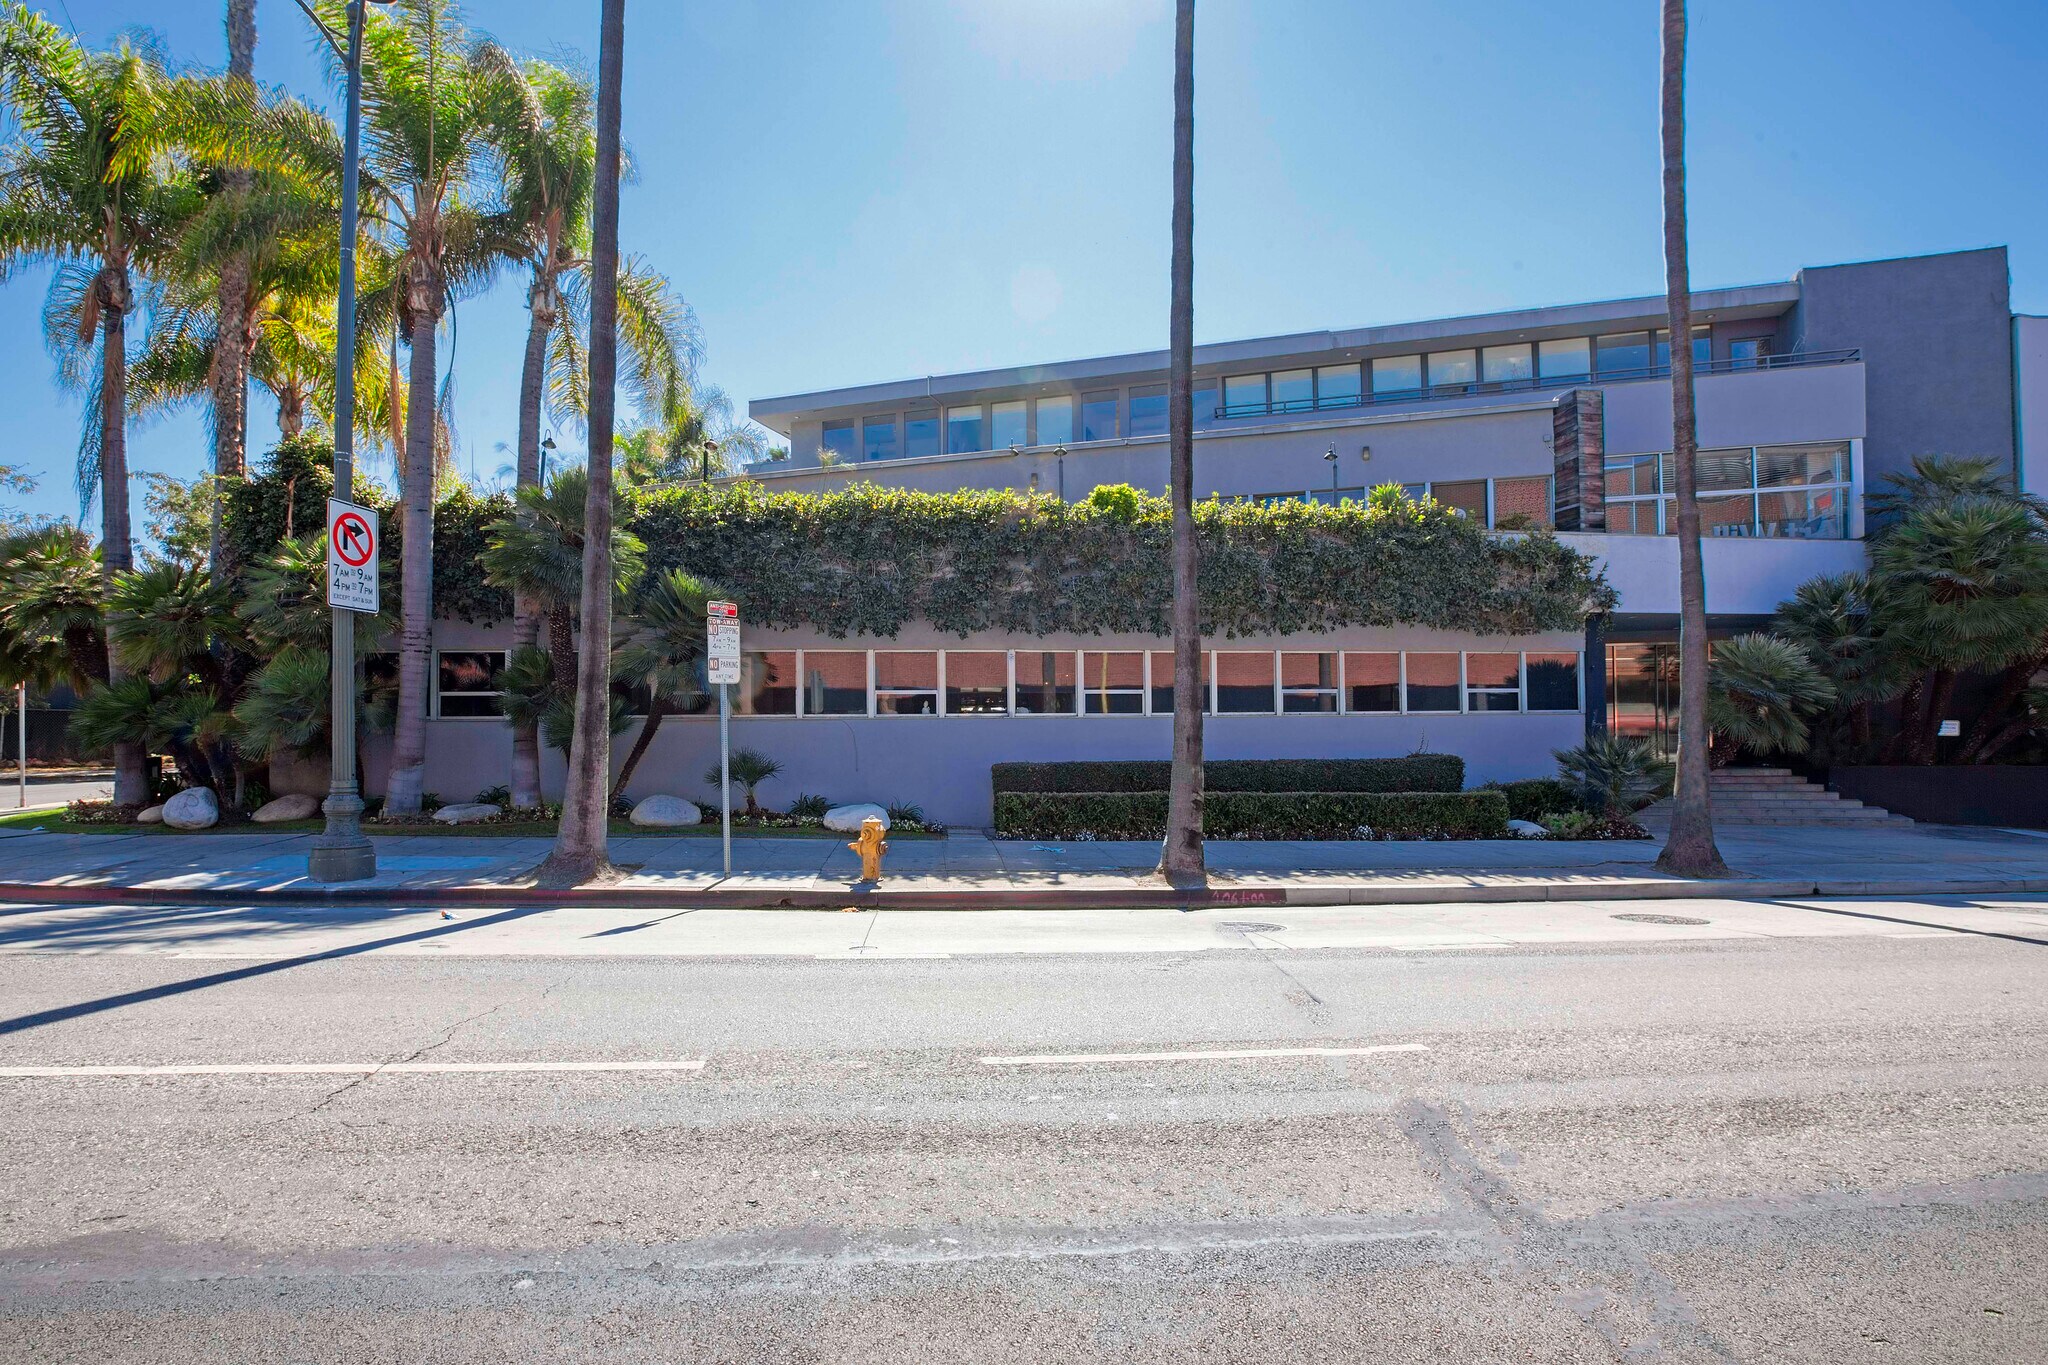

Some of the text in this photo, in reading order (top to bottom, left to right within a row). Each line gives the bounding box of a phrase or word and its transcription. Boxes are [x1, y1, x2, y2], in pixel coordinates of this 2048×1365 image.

[708, 624, 738, 635] NO STOPPING
[709, 659, 738, 669] NO PARKING
